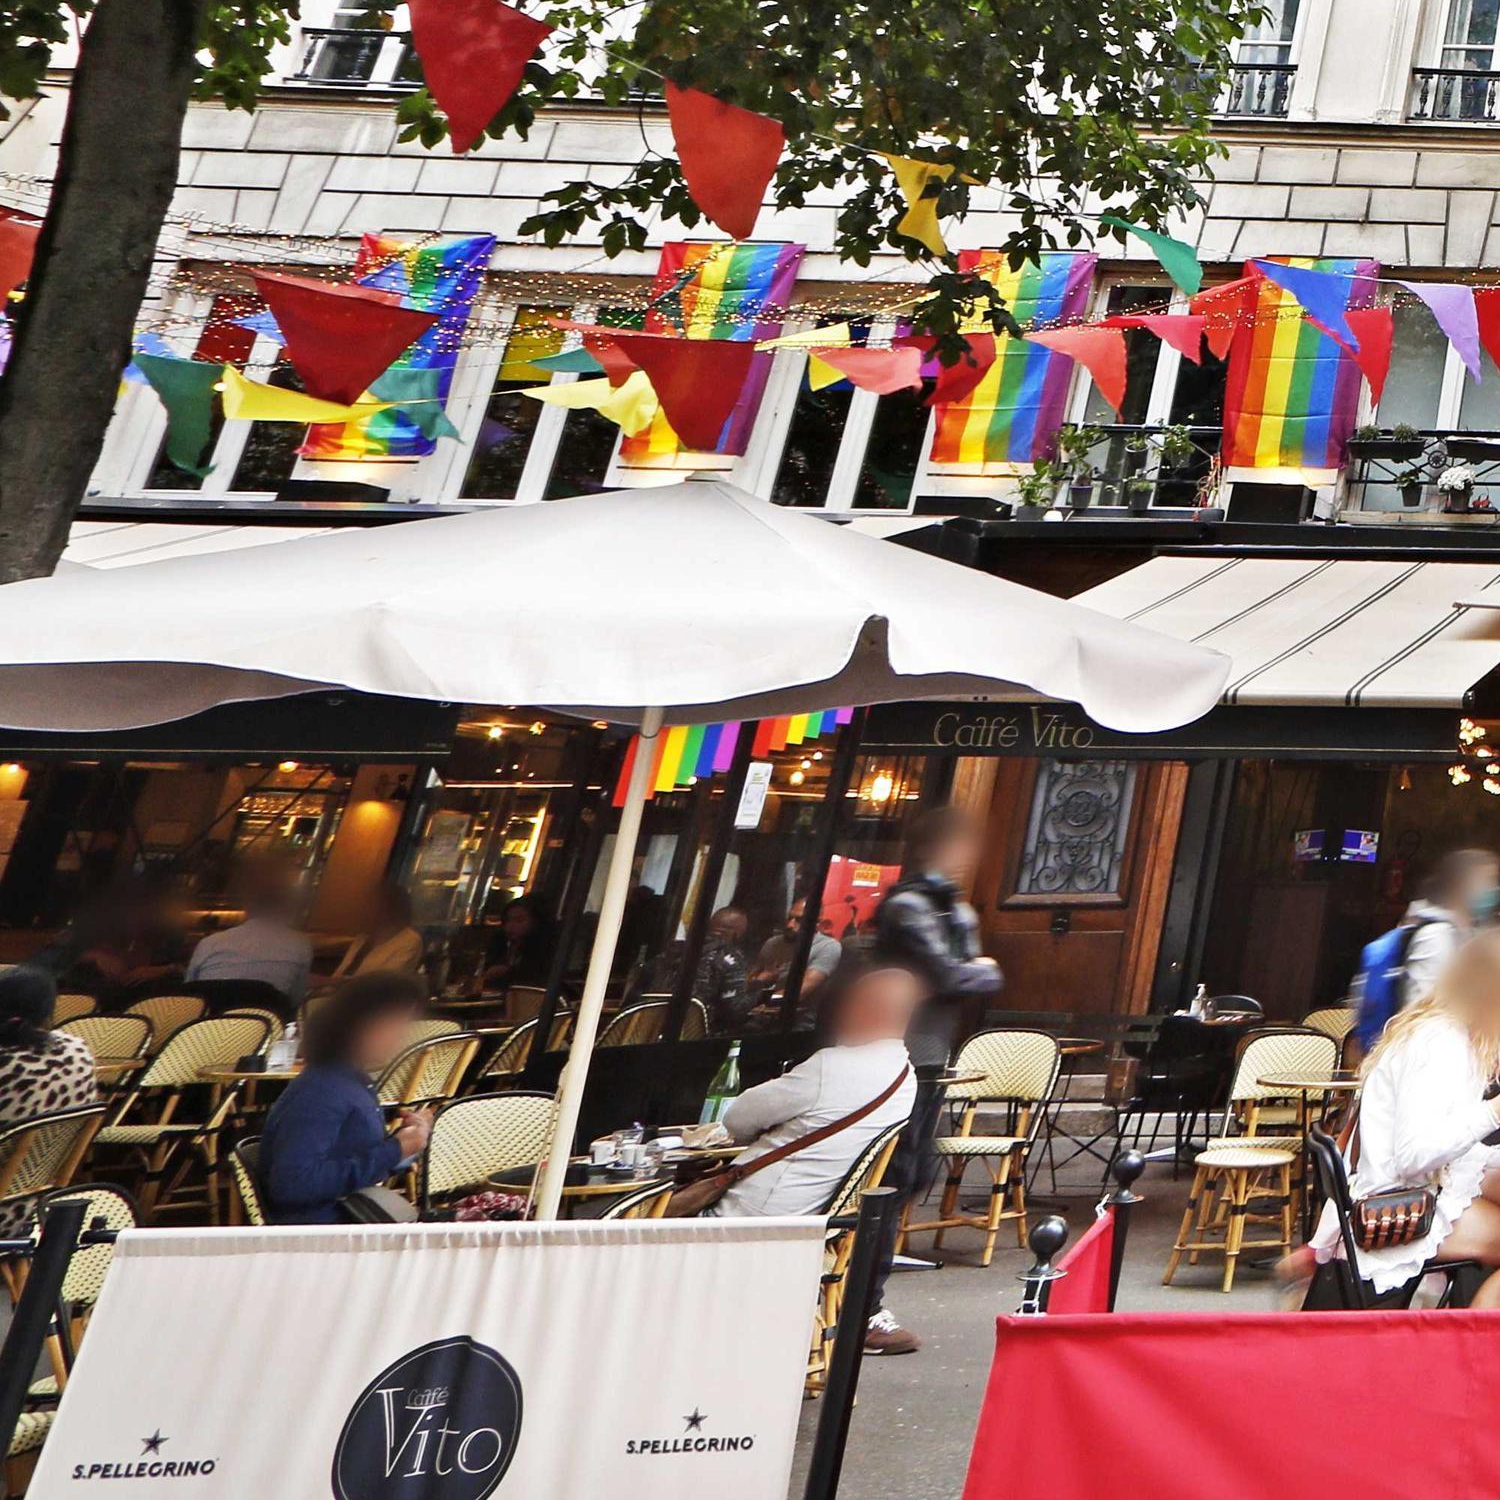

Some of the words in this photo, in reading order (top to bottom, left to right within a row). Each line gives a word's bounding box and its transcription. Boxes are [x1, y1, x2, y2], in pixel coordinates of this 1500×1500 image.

[1030, 706, 1094, 749] Vito
[376, 1387, 502, 1478] Vito
[626, 1436, 754, 1455] S.PELLEGRINO
[72, 1459, 216, 1480] S.PELLEGRINO
